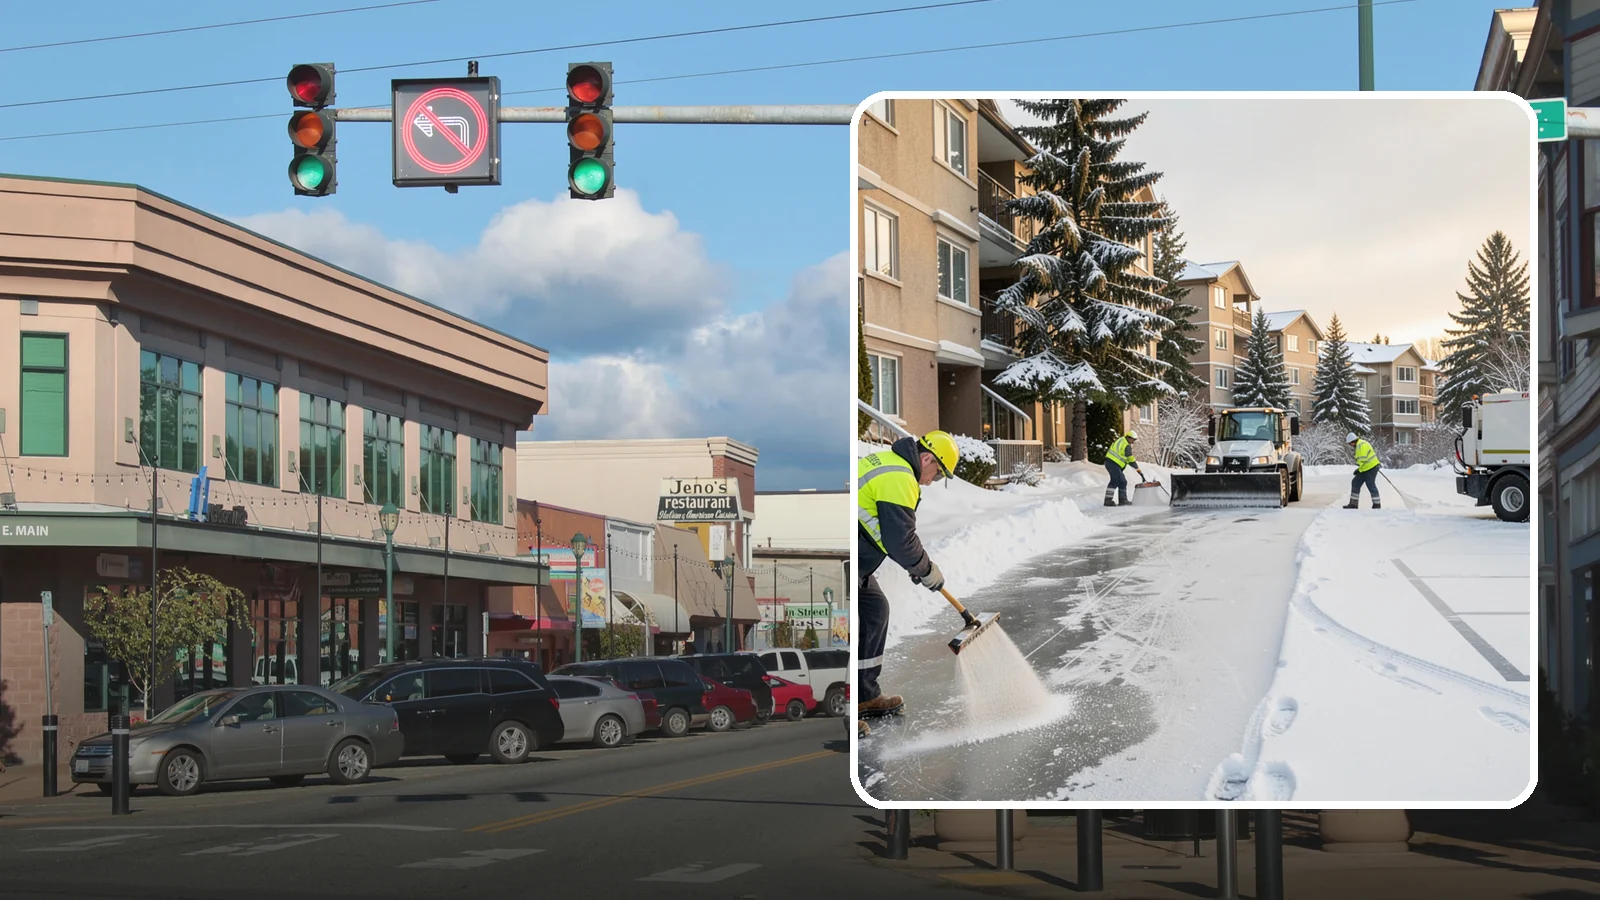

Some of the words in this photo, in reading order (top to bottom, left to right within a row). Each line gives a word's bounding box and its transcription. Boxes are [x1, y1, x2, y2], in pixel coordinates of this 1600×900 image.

[670, 480, 728, 494] Jeno's
[665, 496, 731, 509] restaurant
[658, 509, 682, 520] Italian
[686, 509, 714, 519] American
[715, 509, 737, 519] Cuisine
[2, 525, 13, 536] E.
[15, 525, 49, 537] MAIN
[797, 607, 828, 616] Street
[791, 619, 823, 627] lass
